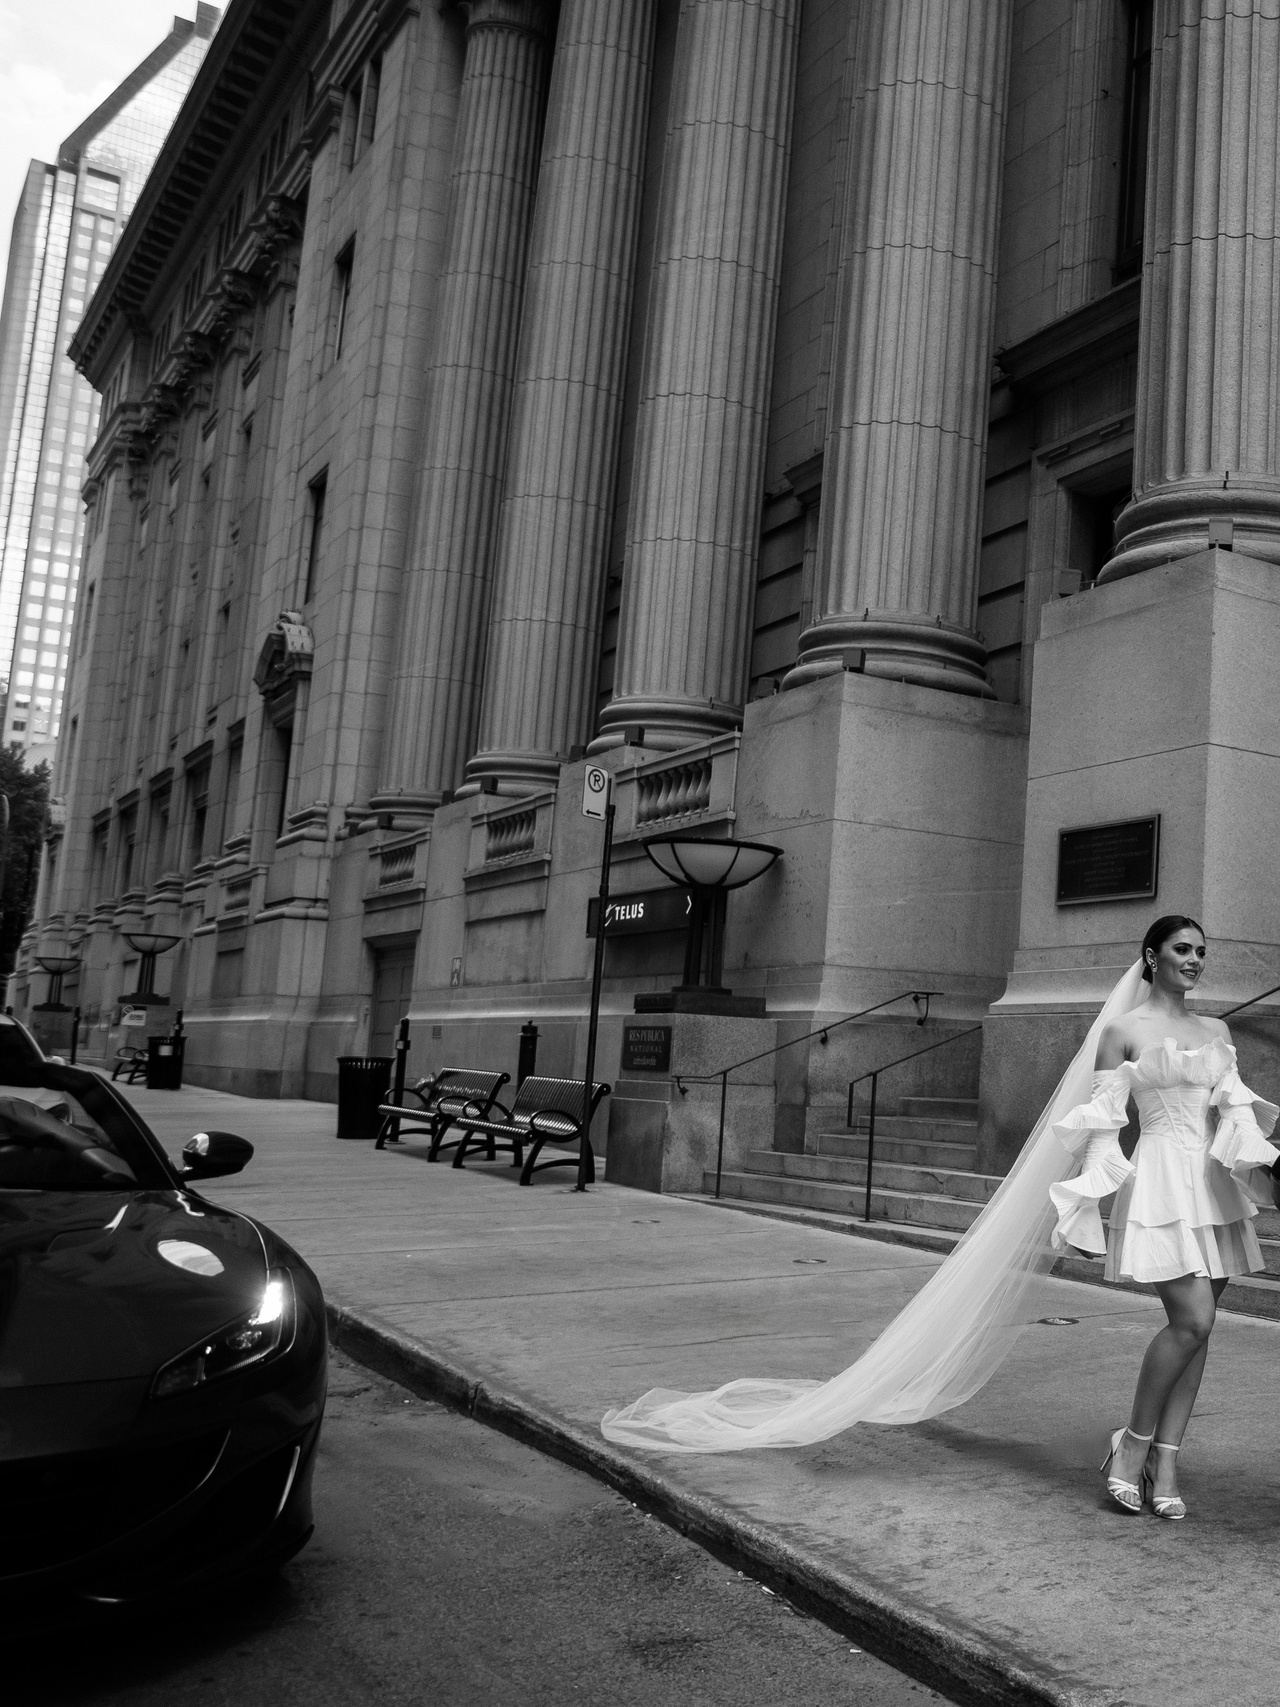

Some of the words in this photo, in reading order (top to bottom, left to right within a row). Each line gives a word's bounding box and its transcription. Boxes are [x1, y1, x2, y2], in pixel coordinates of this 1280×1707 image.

[615, 903, 644, 920] TELUS
[629, 1029, 640, 1041] RES
[640, 1029, 665, 1042] PUBLICA
[630, 1045, 662, 1053] NATIONAL
